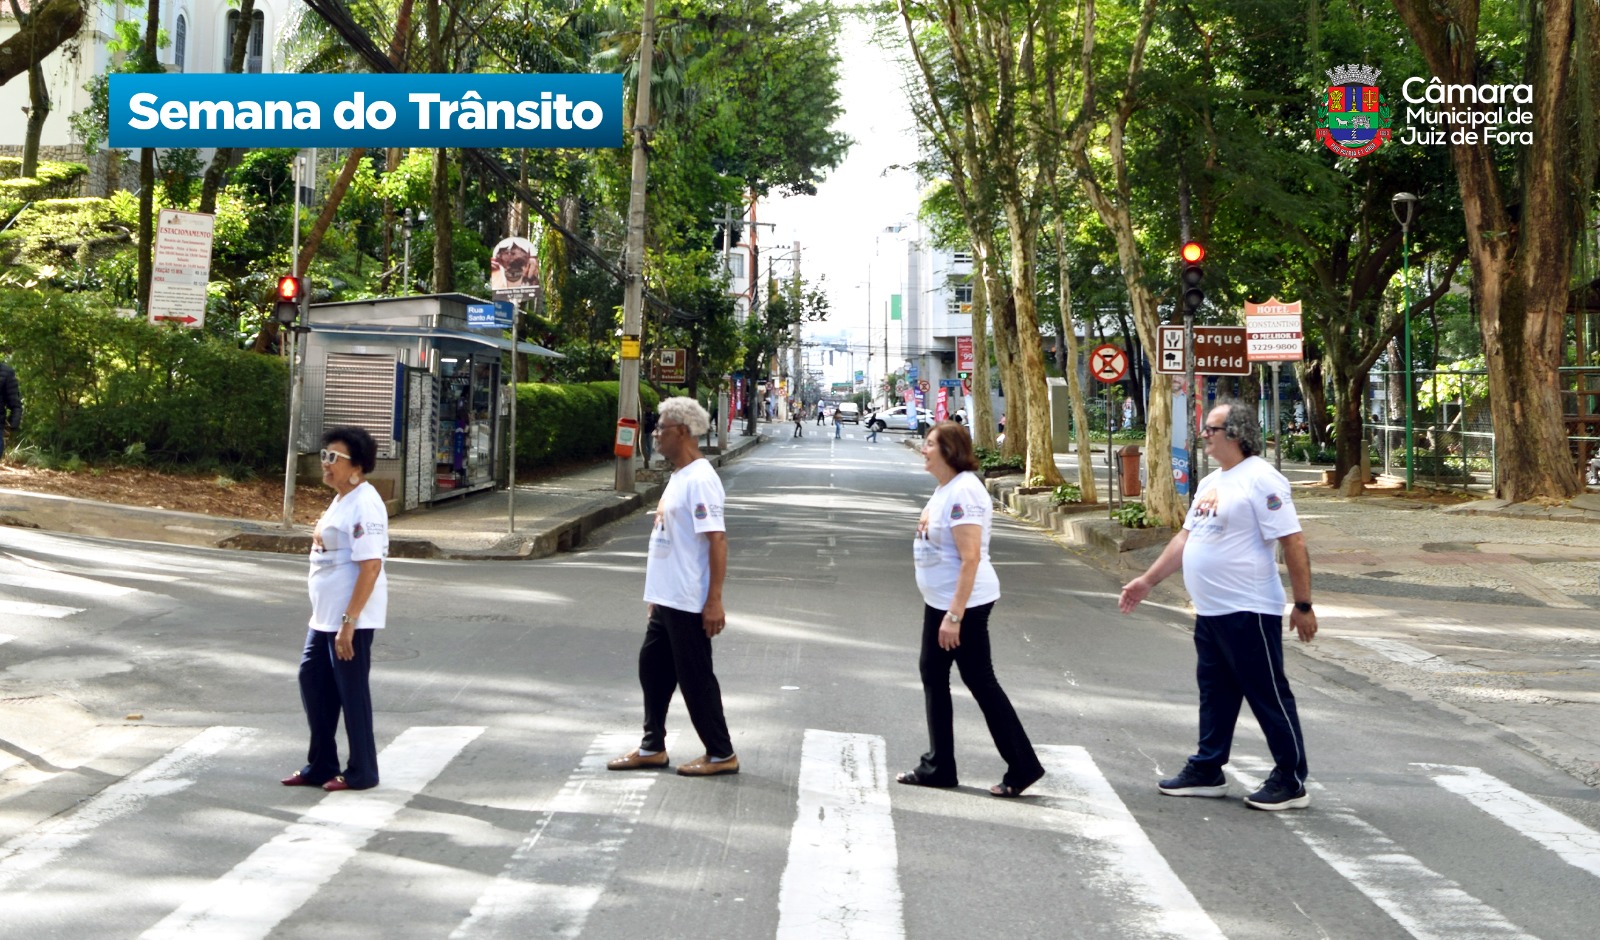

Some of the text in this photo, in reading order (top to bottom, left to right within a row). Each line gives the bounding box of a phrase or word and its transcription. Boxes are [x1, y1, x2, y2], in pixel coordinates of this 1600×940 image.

[160, 226, 211, 239] ESTACIONAMENTO
[1257, 305, 1289, 314] HOTEL
[1248, 320, 1300, 329] CONSTANTINO
[1252, 343, 1298, 351] 3229-9800
[1194, 355, 1243, 368] alfeld
